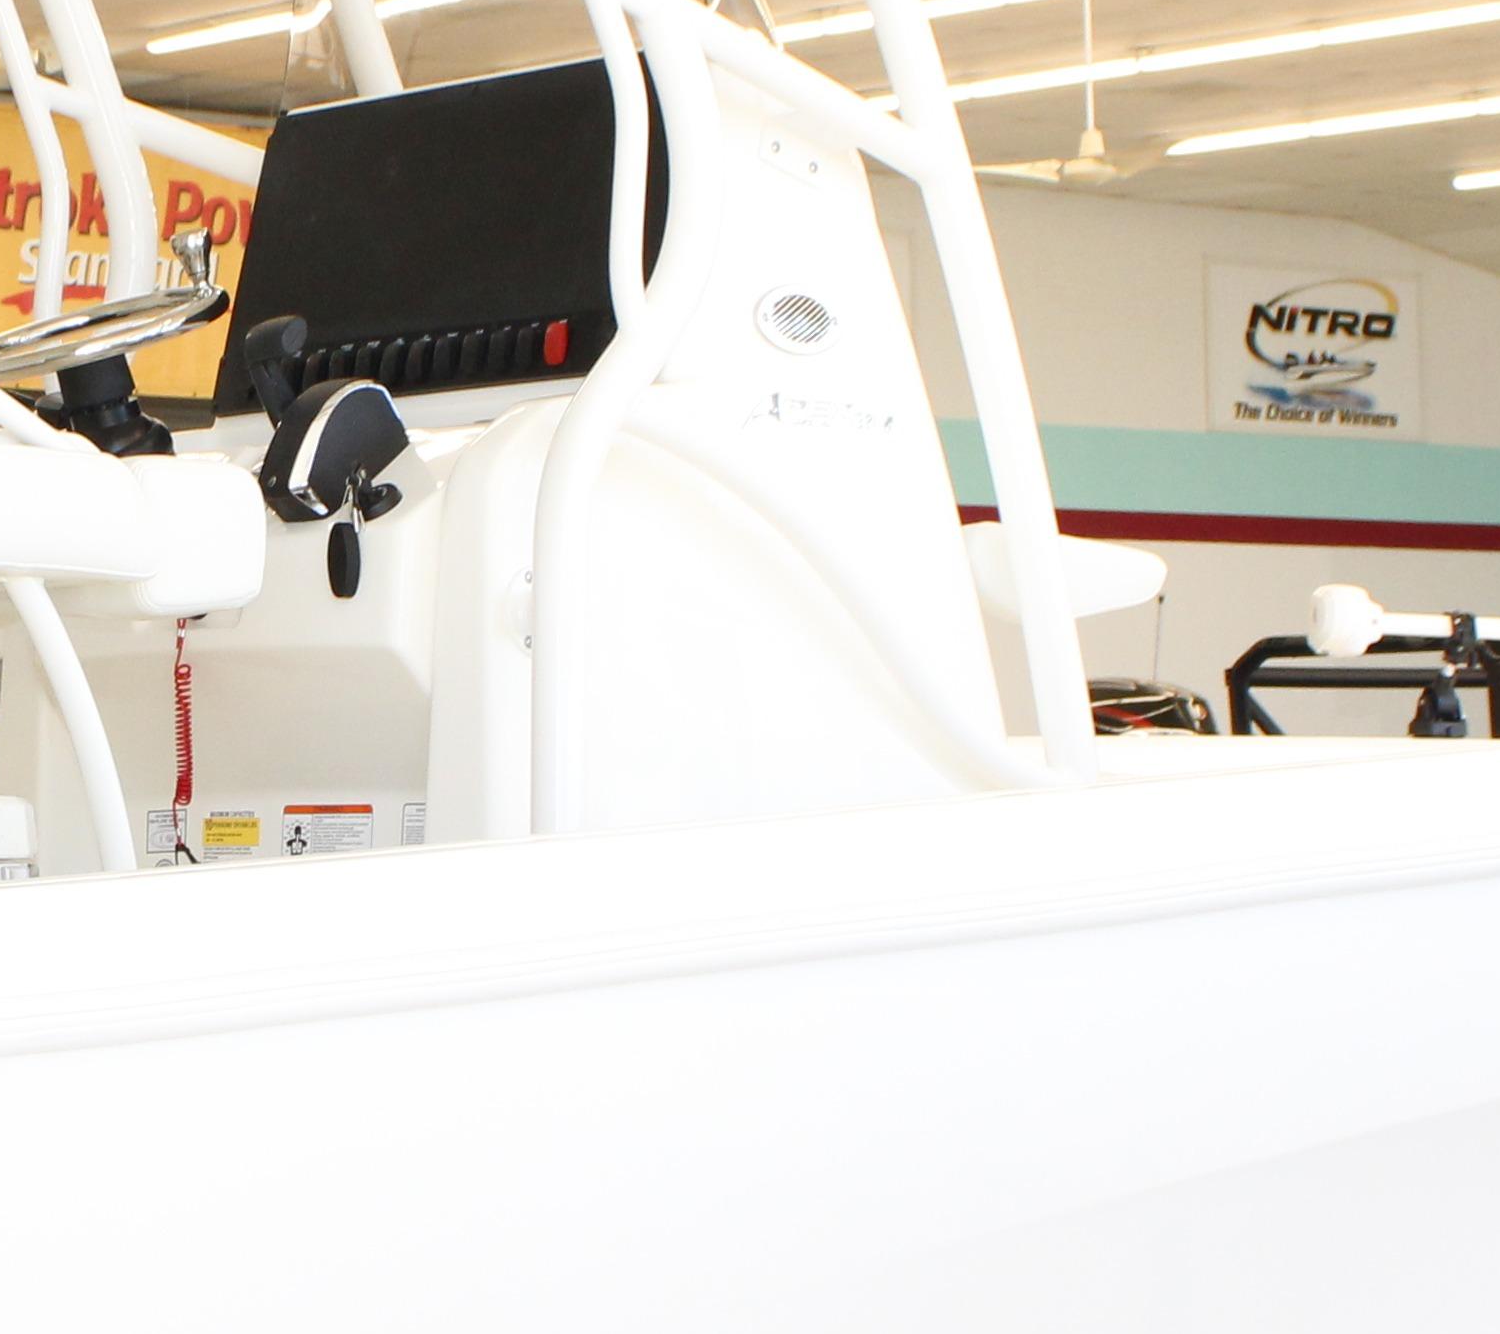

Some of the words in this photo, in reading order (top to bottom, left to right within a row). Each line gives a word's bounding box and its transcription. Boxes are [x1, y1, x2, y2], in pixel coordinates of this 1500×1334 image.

[1234, 401, 1261, 421] The
[1266, 403, 1314, 423] Choice
[1318, 406, 1337, 424] of
[1339, 409, 1398, 428] Winners
